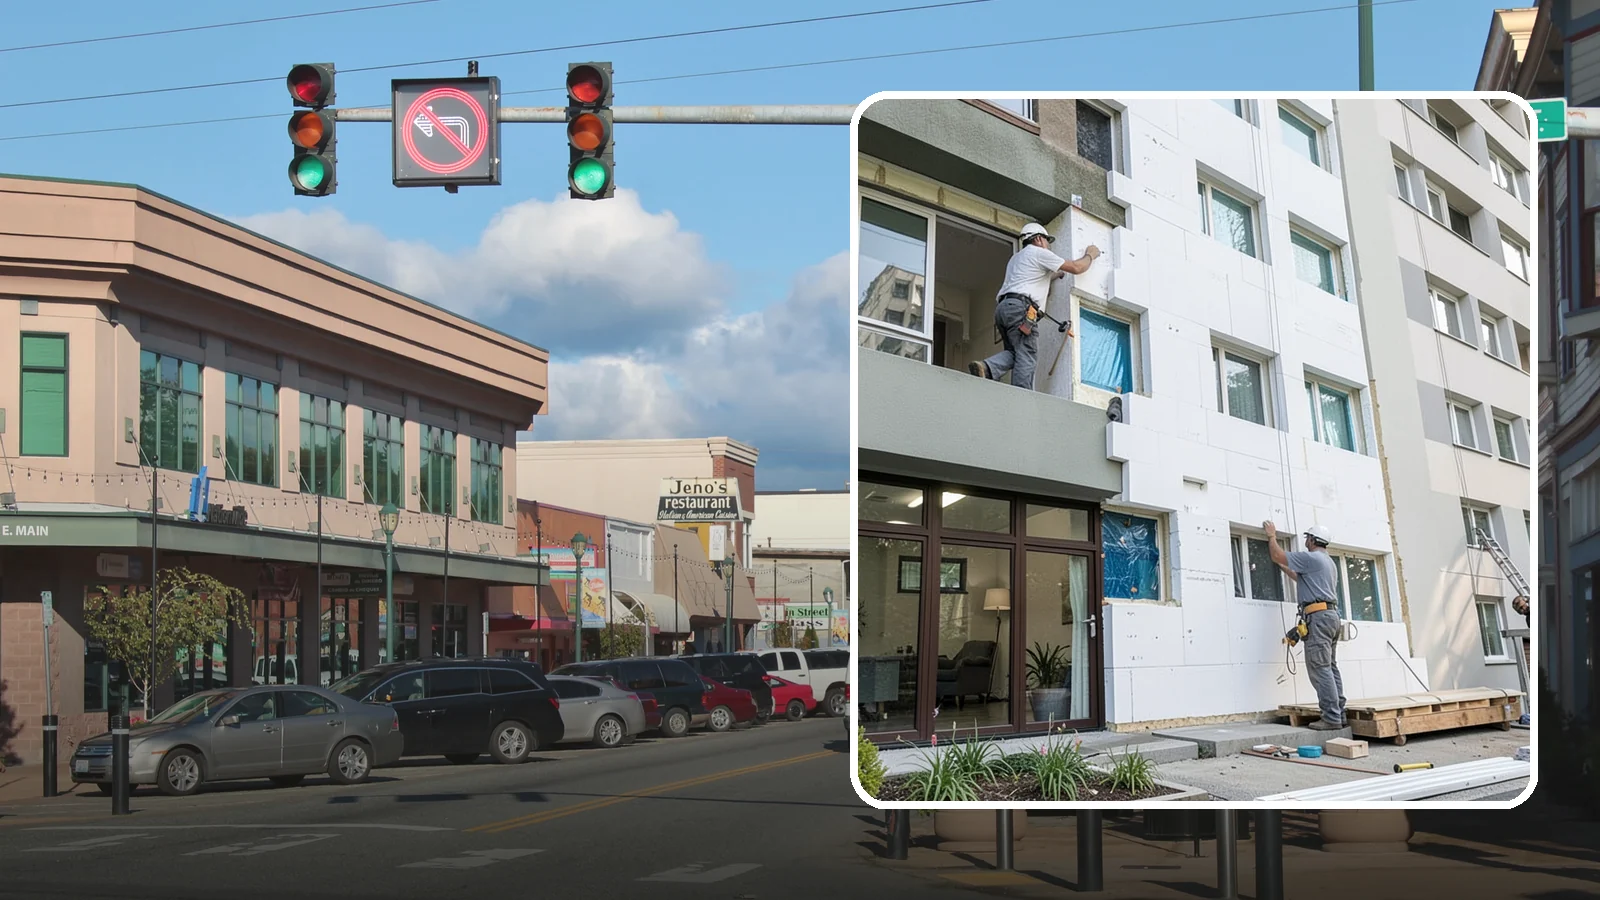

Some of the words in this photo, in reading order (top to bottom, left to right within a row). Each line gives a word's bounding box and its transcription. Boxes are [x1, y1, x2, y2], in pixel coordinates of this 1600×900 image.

[670, 480, 727, 495] Jeno's
[665, 496, 731, 509] restaurant
[658, 509, 681, 519] Italian
[686, 509, 714, 519] American
[715, 509, 737, 519] Cuisine
[2, 525, 13, 536] E.
[15, 525, 49, 536] MAIN
[797, 607, 828, 617] Street
